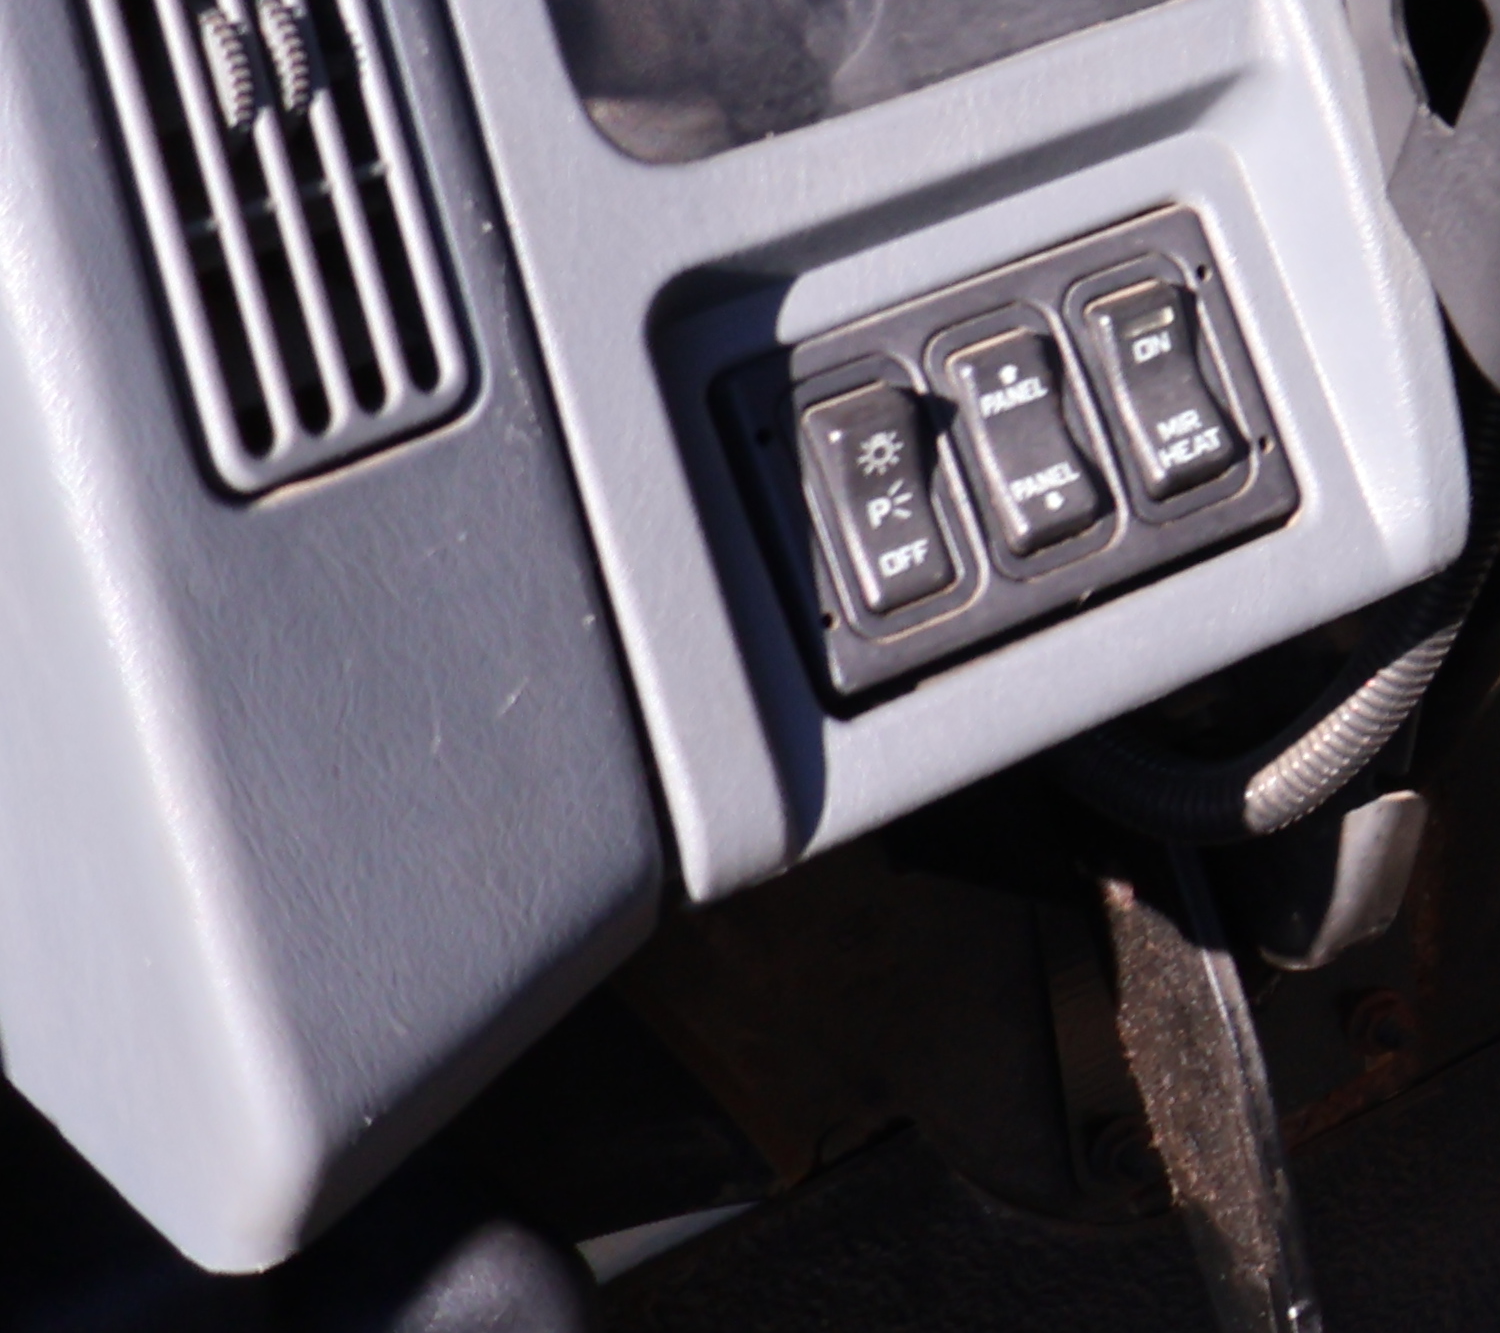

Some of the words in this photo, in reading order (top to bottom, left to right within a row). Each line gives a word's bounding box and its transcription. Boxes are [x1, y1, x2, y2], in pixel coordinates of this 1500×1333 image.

[1131, 331, 1172, 364] ON
[978, 376, 1049, 418] PANEL
[1156, 408, 1202, 441] MIR
[1157, 426, 1221, 470] HEAT
[1008, 460, 1081, 503] PANEL
[877, 537, 929, 579] OFF
